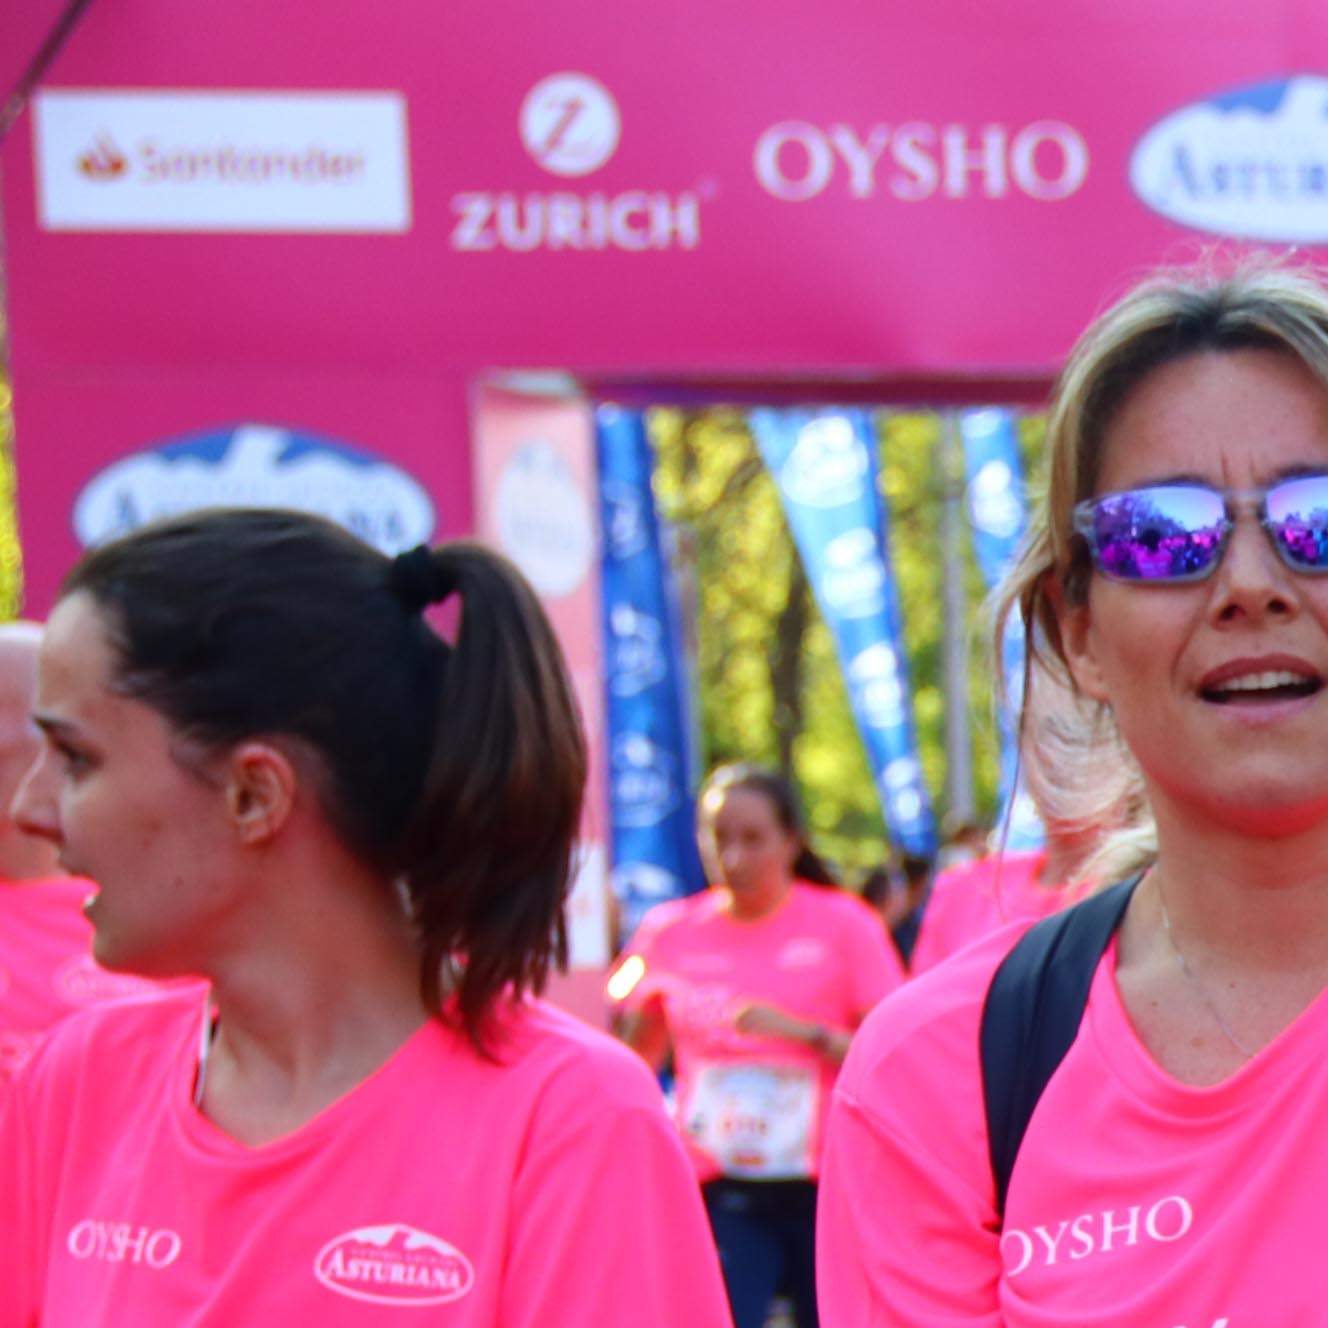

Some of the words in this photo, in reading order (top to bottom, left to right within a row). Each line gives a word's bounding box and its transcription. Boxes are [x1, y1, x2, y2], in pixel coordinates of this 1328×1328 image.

[138, 139, 366, 186] Santander
[753, 119, 1089, 202] OYSHO
[449, 192, 702, 252] ZURICH
[1001, 1195, 1193, 1277] OYSHO
[324, 1249, 463, 1289] ASTURIANA
